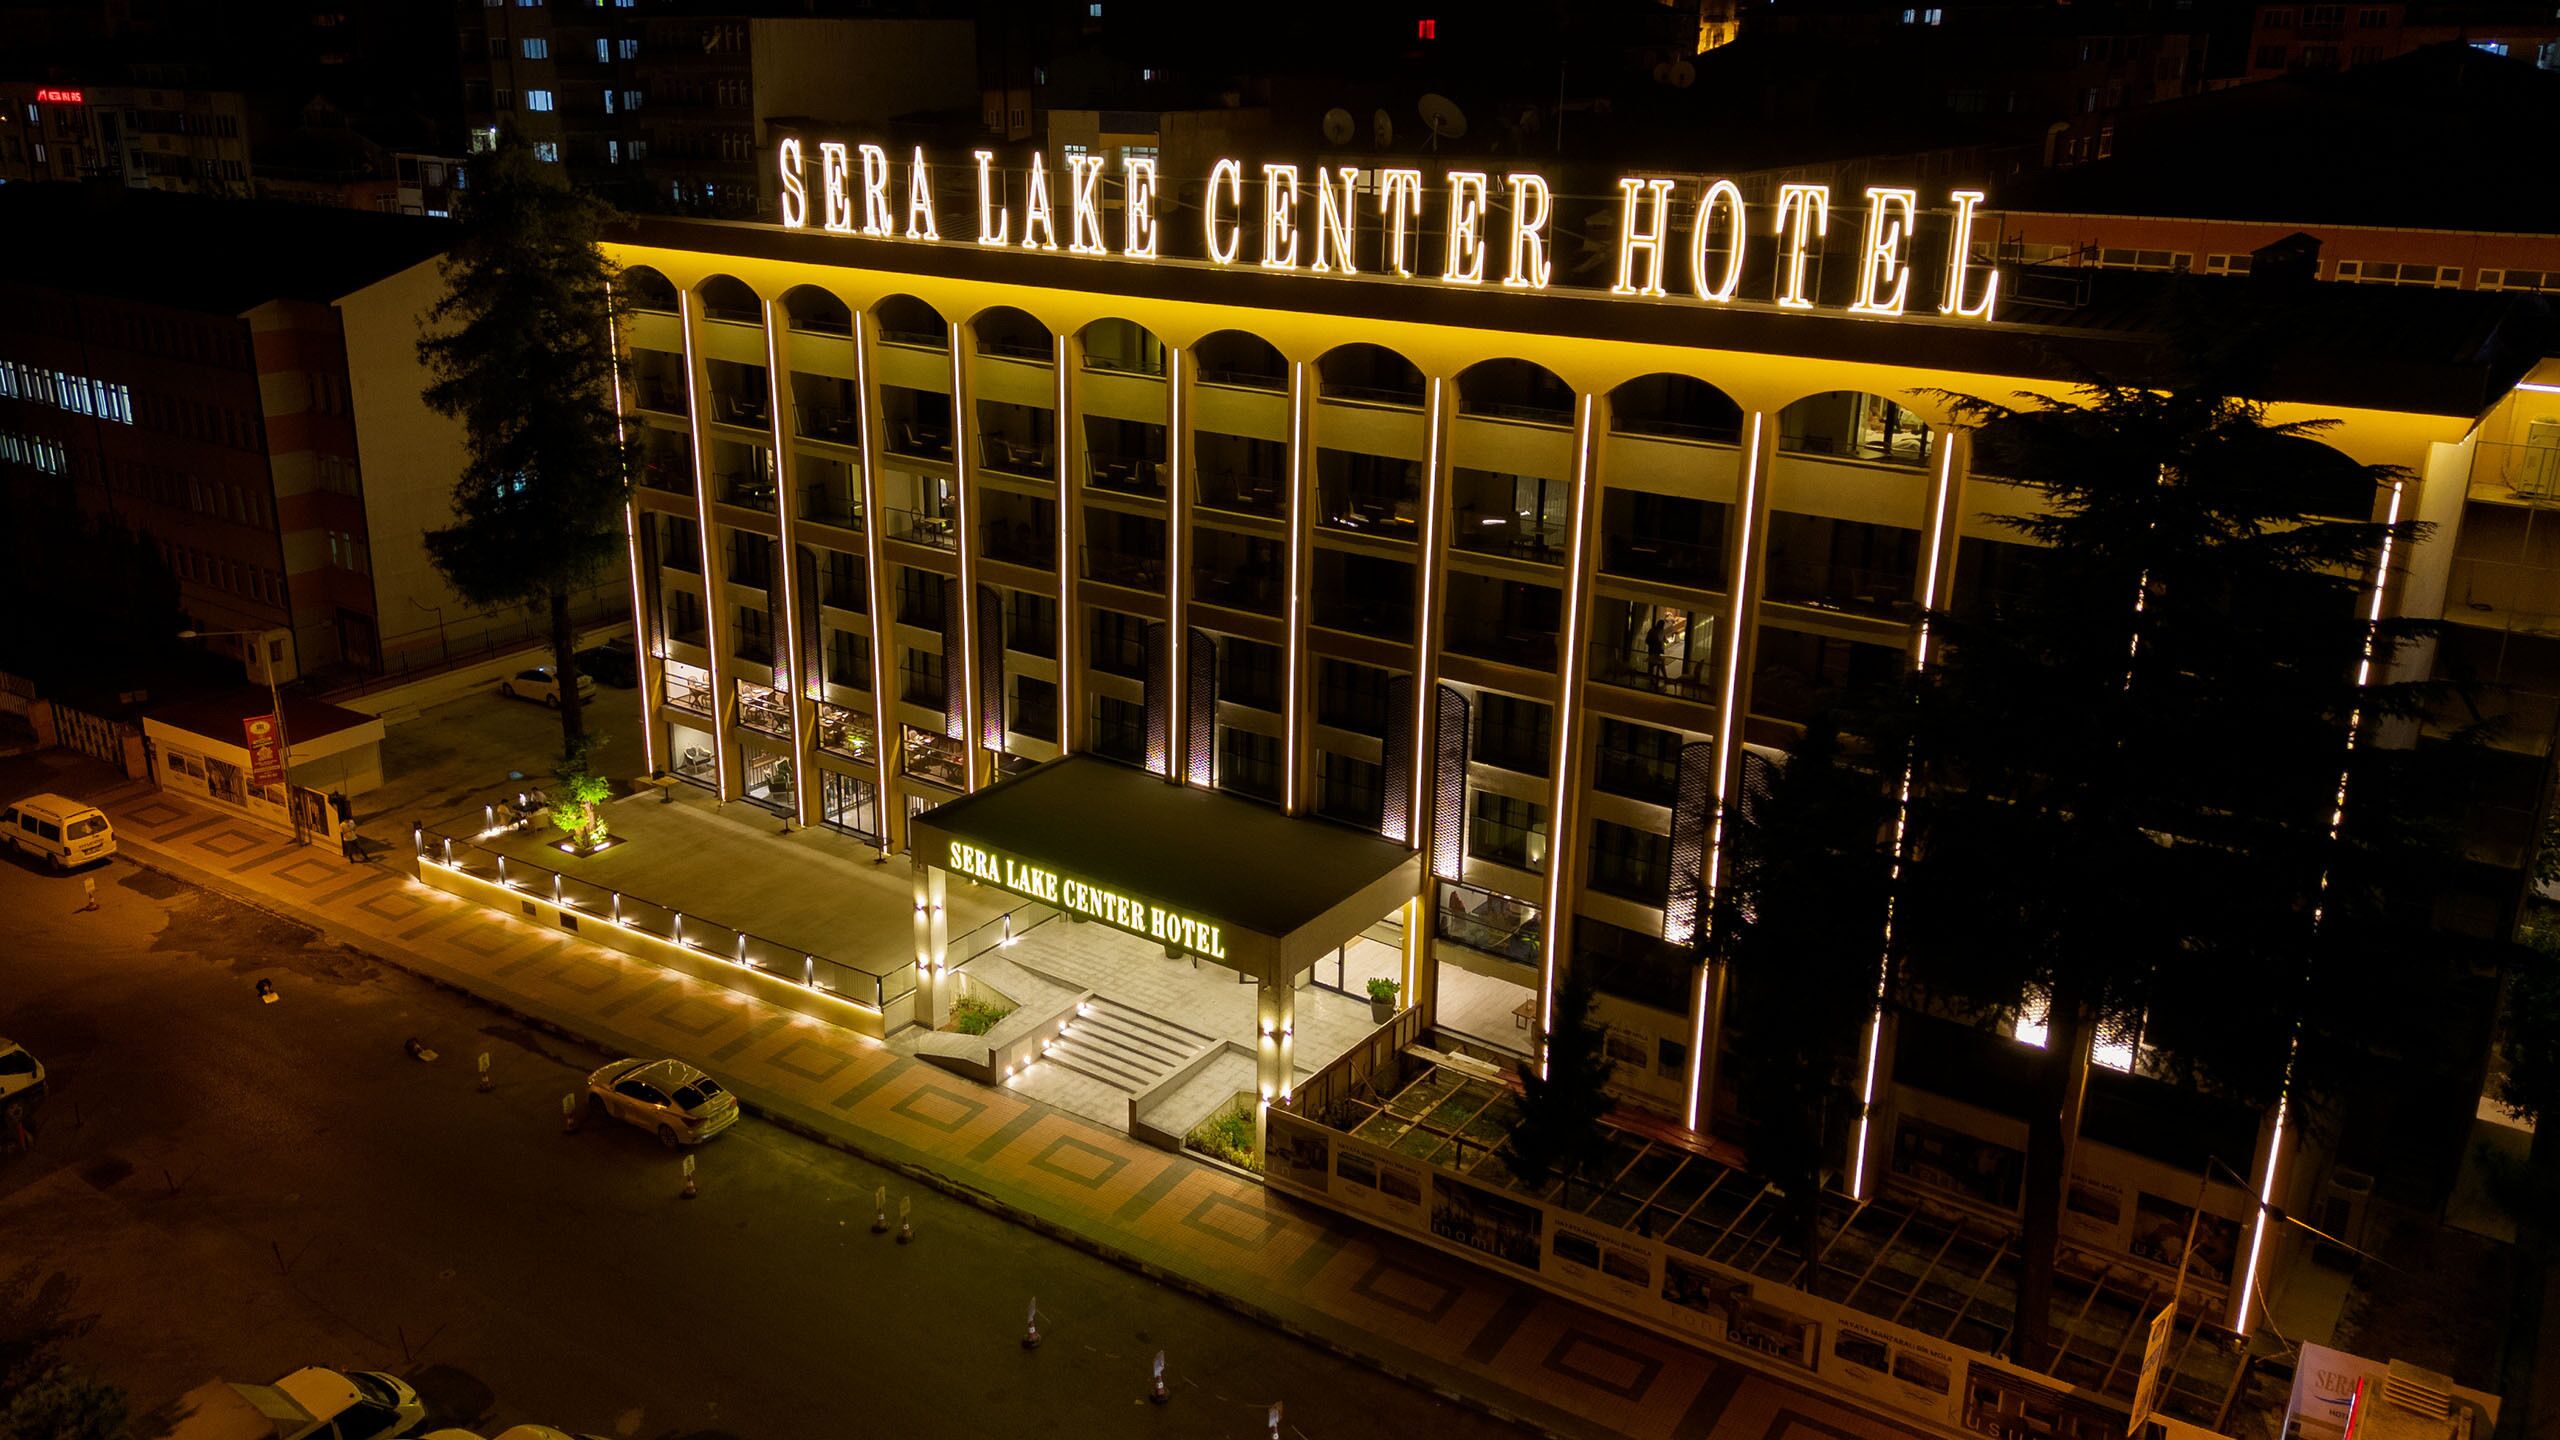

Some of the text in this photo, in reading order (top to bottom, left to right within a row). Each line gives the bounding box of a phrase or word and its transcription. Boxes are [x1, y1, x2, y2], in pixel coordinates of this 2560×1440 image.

[778, 137, 2000, 323] SERA LAKE CENTER HOTEL
[949, 841, 1226, 960] SERA LAKE CENTER HOTEL
